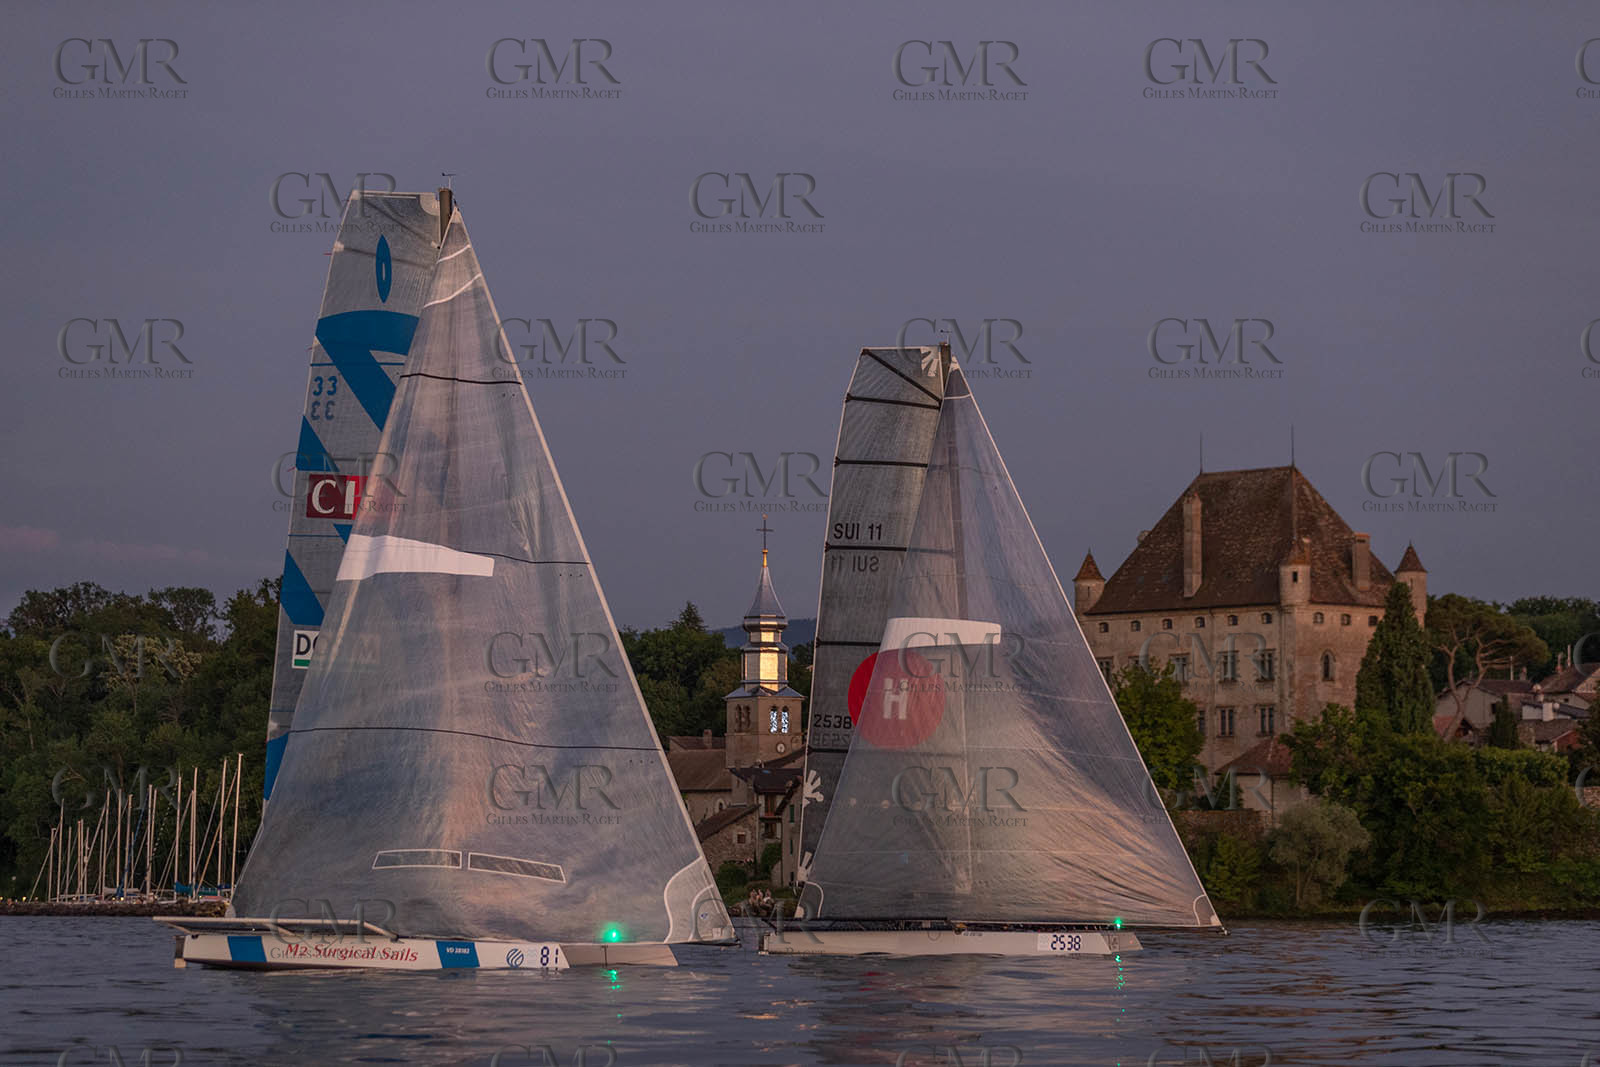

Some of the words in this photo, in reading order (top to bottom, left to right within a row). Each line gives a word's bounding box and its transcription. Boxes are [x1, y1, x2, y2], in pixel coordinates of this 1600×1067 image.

[312, 375, 338, 396] 33
[834, 523, 860, 540] SUI
[868, 523, 882, 541] 11
[882, 678, 909, 720] H
[814, 714, 852, 729] 2538
[1050, 934, 1082, 951] 2538
[284, 944, 308, 957] M2
[312, 944, 377, 961] Surgical
[380, 947, 419, 962] Sails
[540, 946, 558, 966] 81
